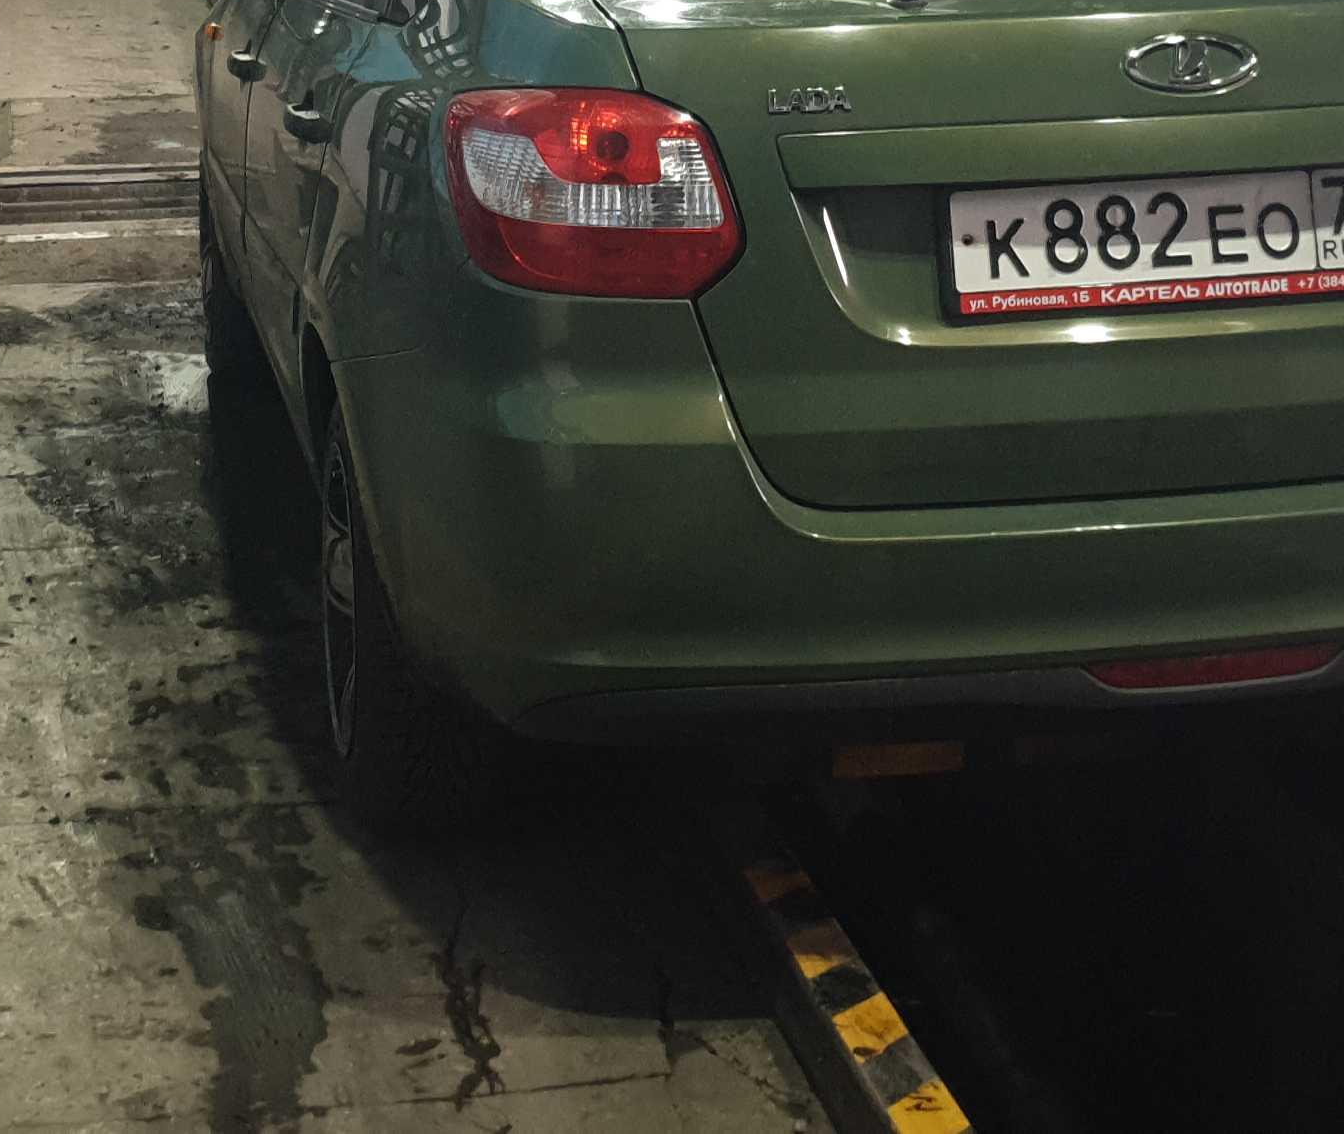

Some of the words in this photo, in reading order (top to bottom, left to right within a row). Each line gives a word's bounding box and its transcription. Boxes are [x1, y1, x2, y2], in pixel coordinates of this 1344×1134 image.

[768, 86, 852, 114] LADA
[986, 192, 1300, 279] К882ЕО
[969, 298, 988, 311] ул.
[992, 294, 1068, 310] Рубиновая,
[1101, 284, 1200, 304] КАРТЕЛЬ
[1205, 278, 1289, 297] AUTOTRADE
[1297, 276, 1314, 289] +7
